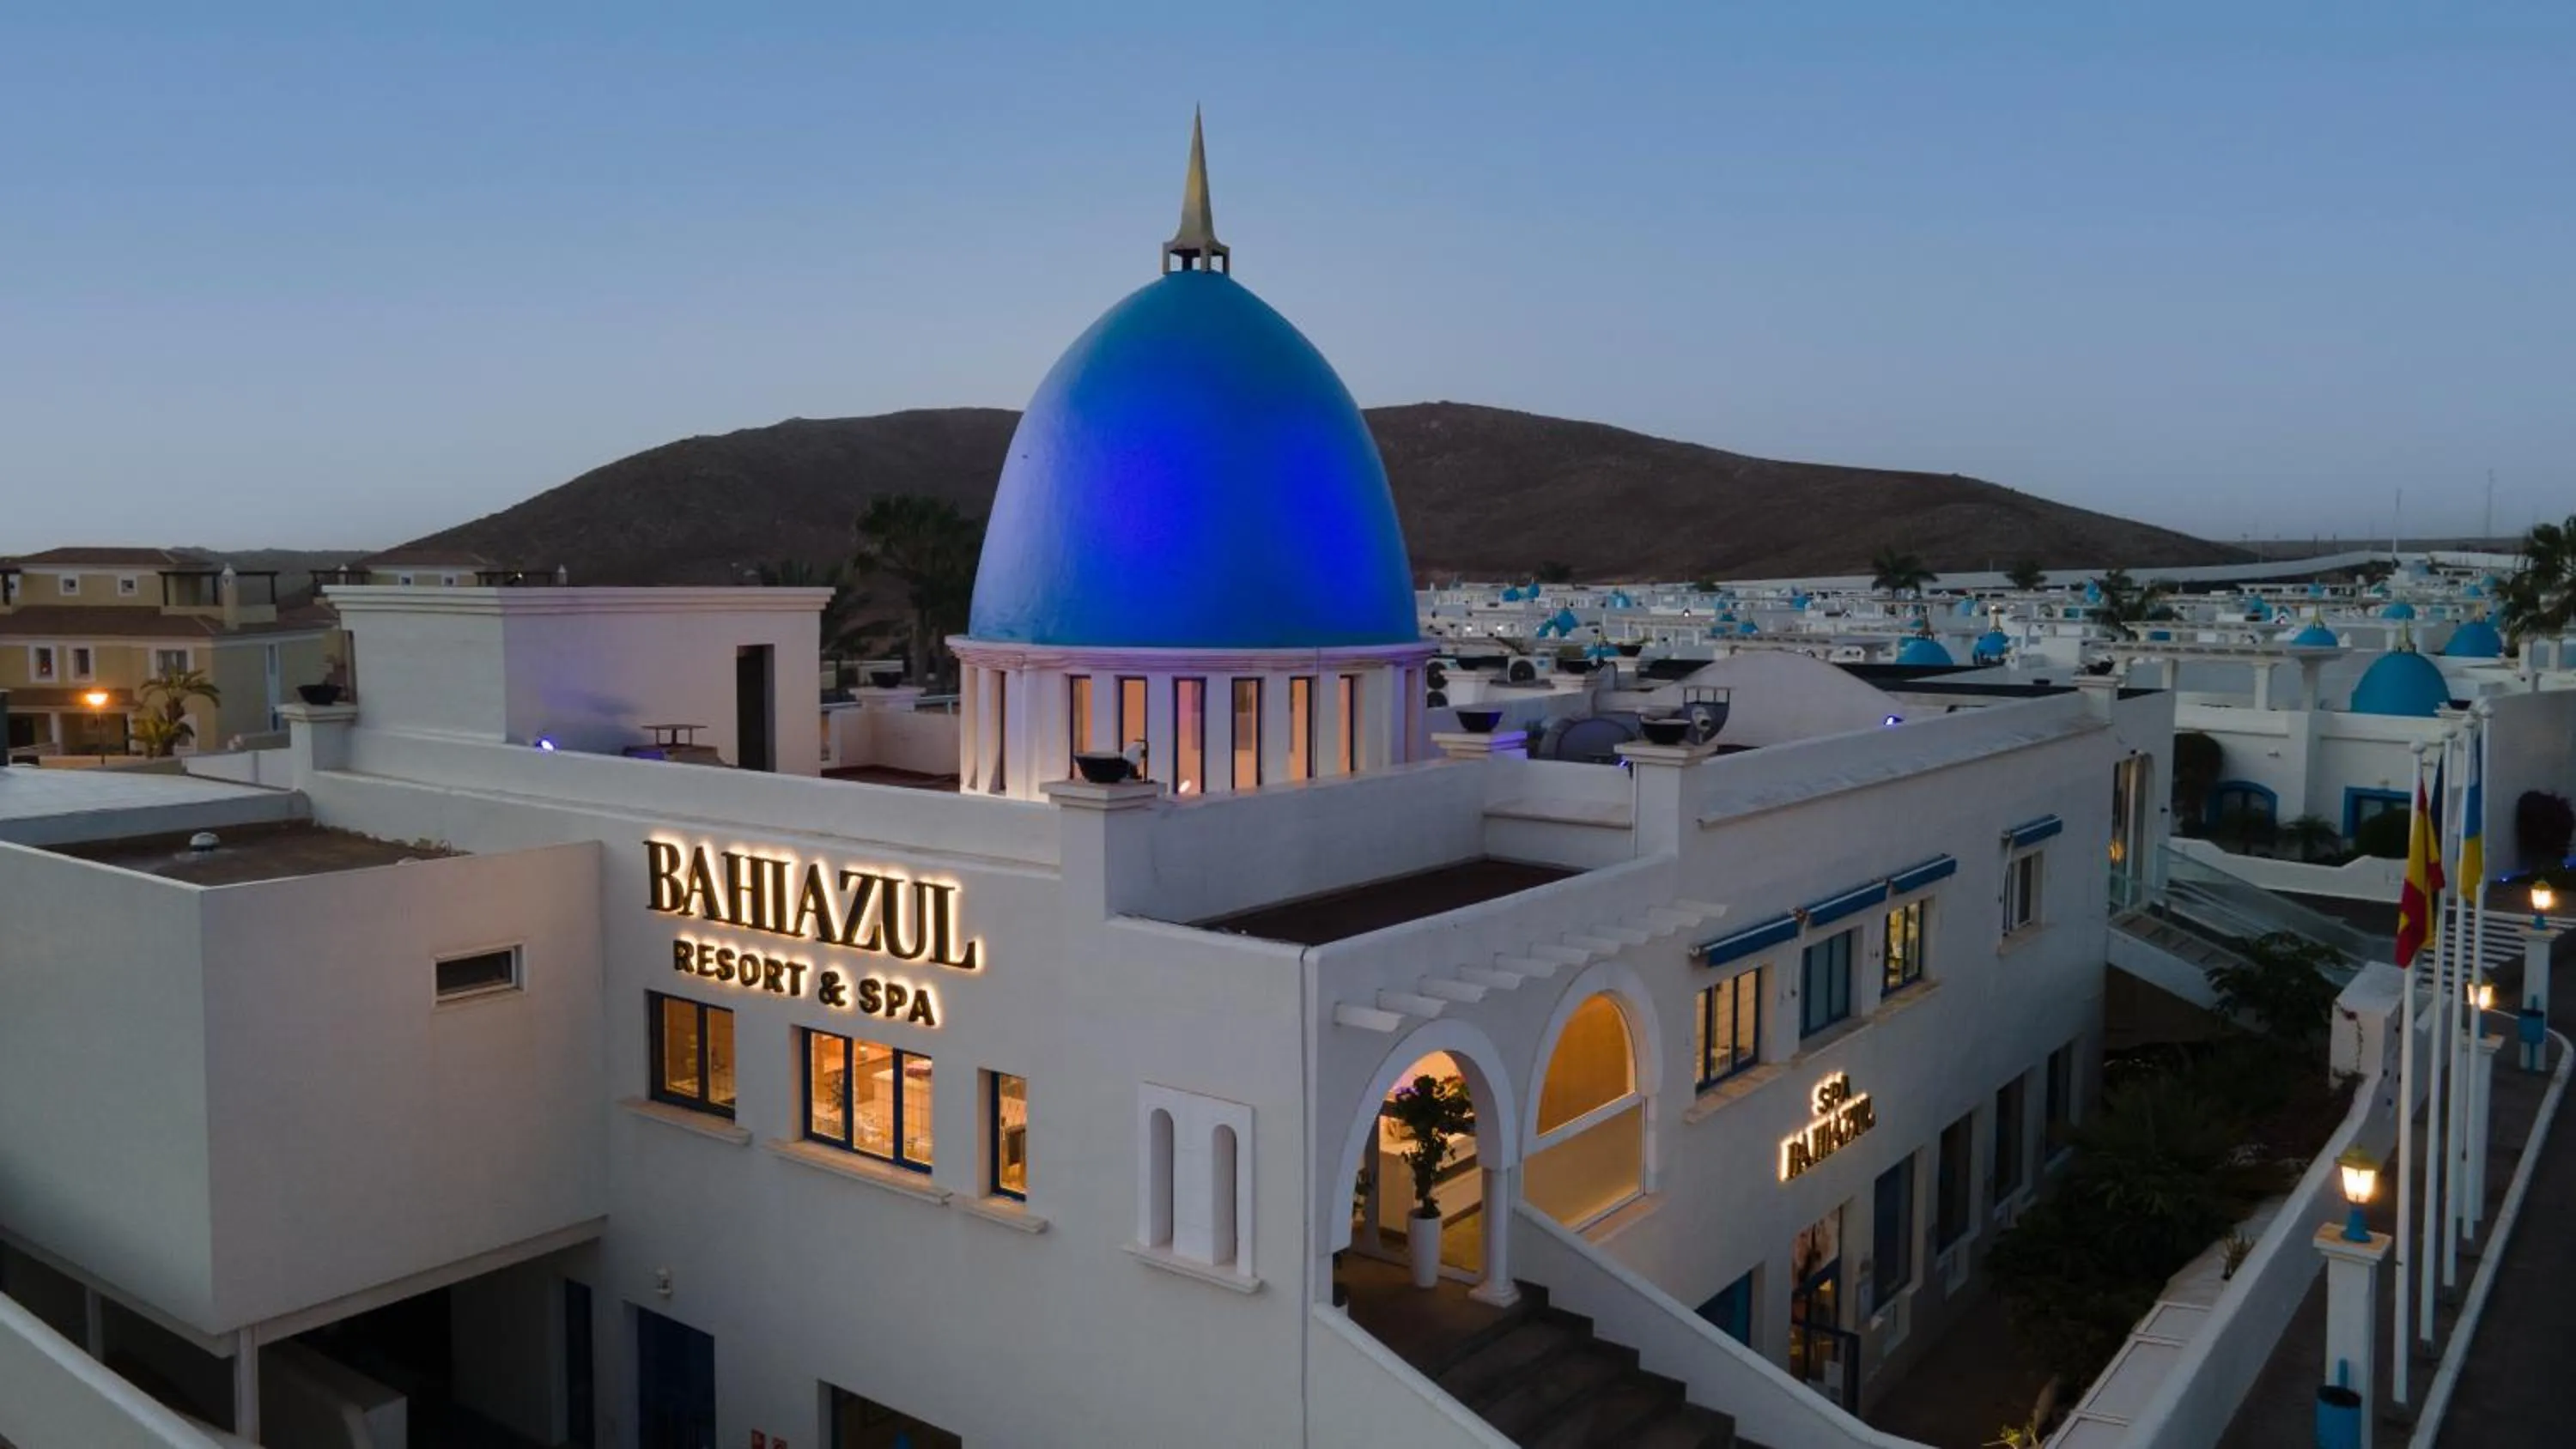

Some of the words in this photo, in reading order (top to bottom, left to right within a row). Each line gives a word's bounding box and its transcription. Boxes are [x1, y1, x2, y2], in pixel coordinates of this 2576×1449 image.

[642, 840, 977, 970] BAHIAZUL
[672, 938, 808, 997] RESORT
[817, 970, 848, 1007] &
[859, 978, 937, 1027] SPA
[1815, 1073, 1852, 1114] SPA
